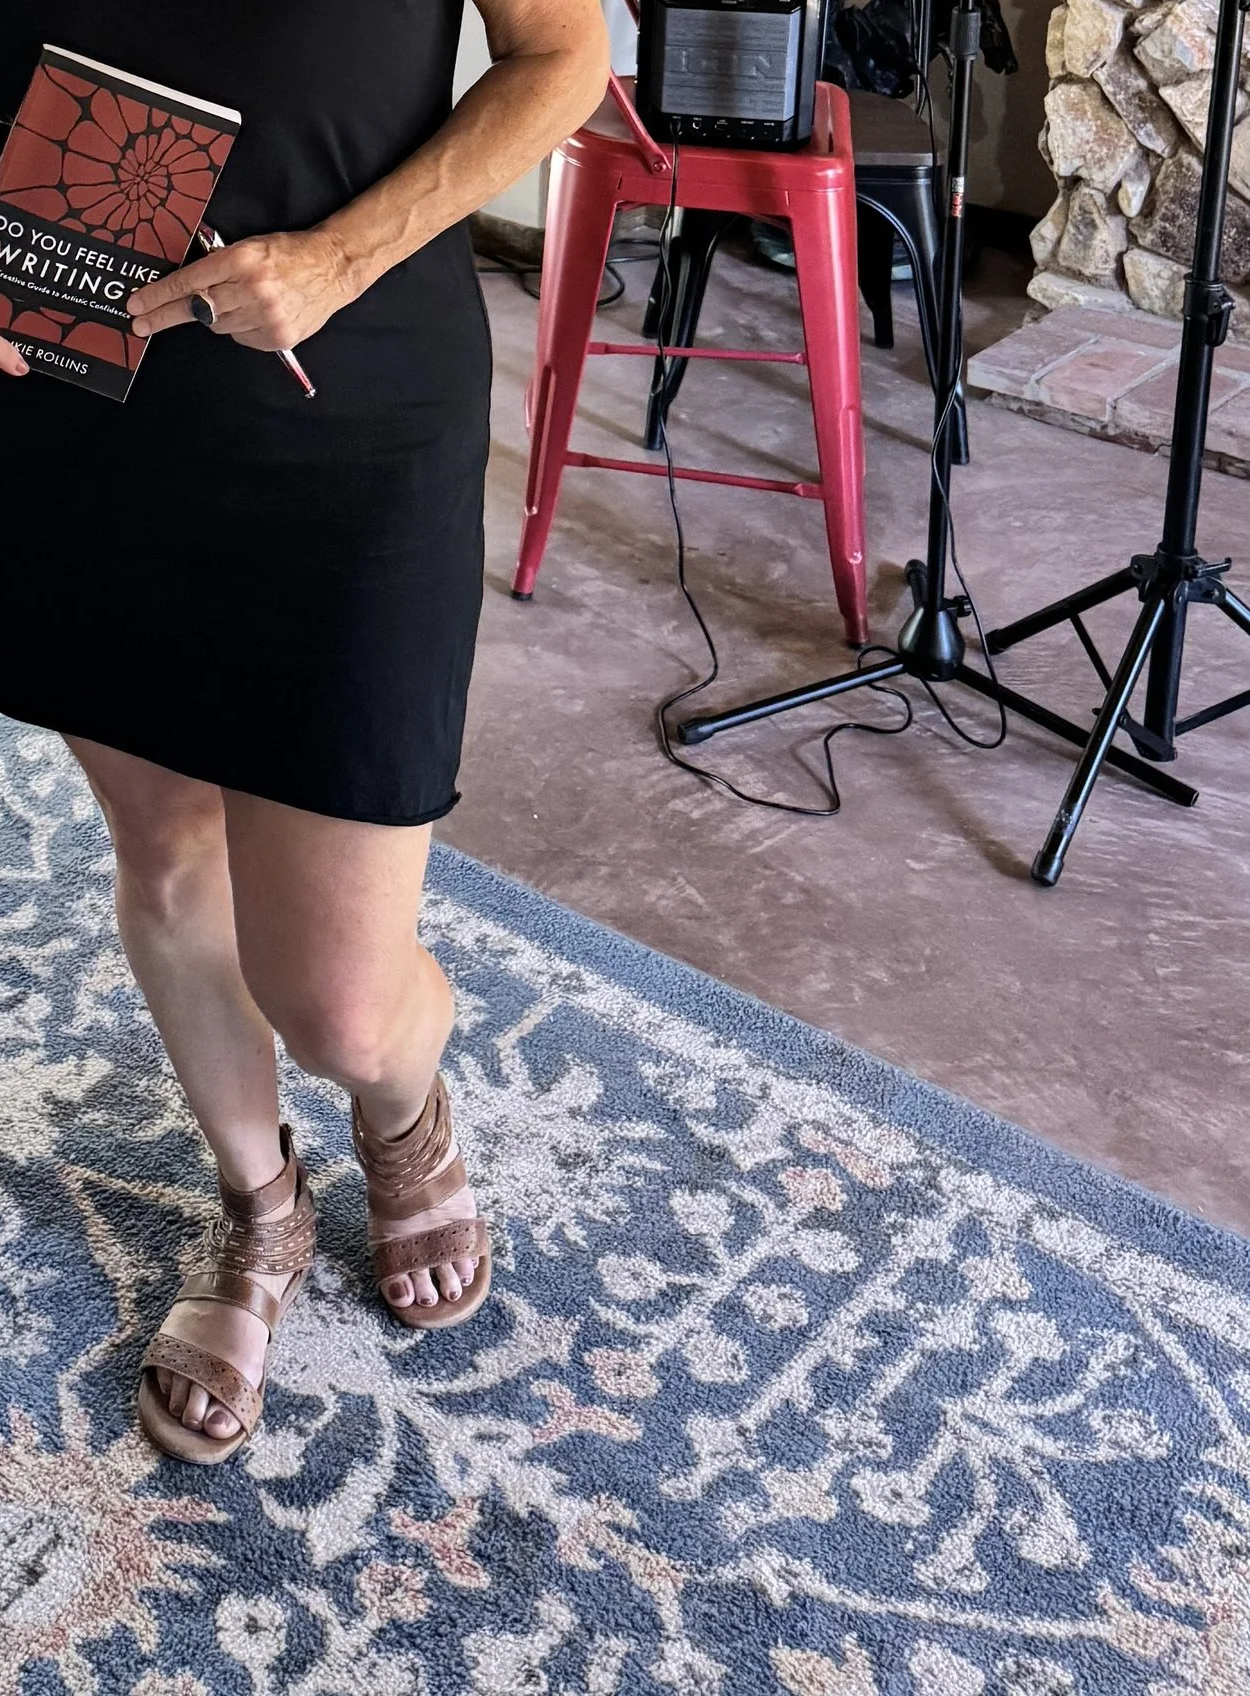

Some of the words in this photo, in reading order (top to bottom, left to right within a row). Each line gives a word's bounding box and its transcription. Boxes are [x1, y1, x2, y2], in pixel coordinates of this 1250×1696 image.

[31, 229, 71, 256] YOU
[74, 246, 114, 272] FEEL
[119, 261, 160, 284] LIKE
[27, 282, 50, 295] Guide
[61, 293, 88, 306] Artistic
[89, 300, 131, 319] Confidence
[35, 348, 89, 375] ROLLINS
